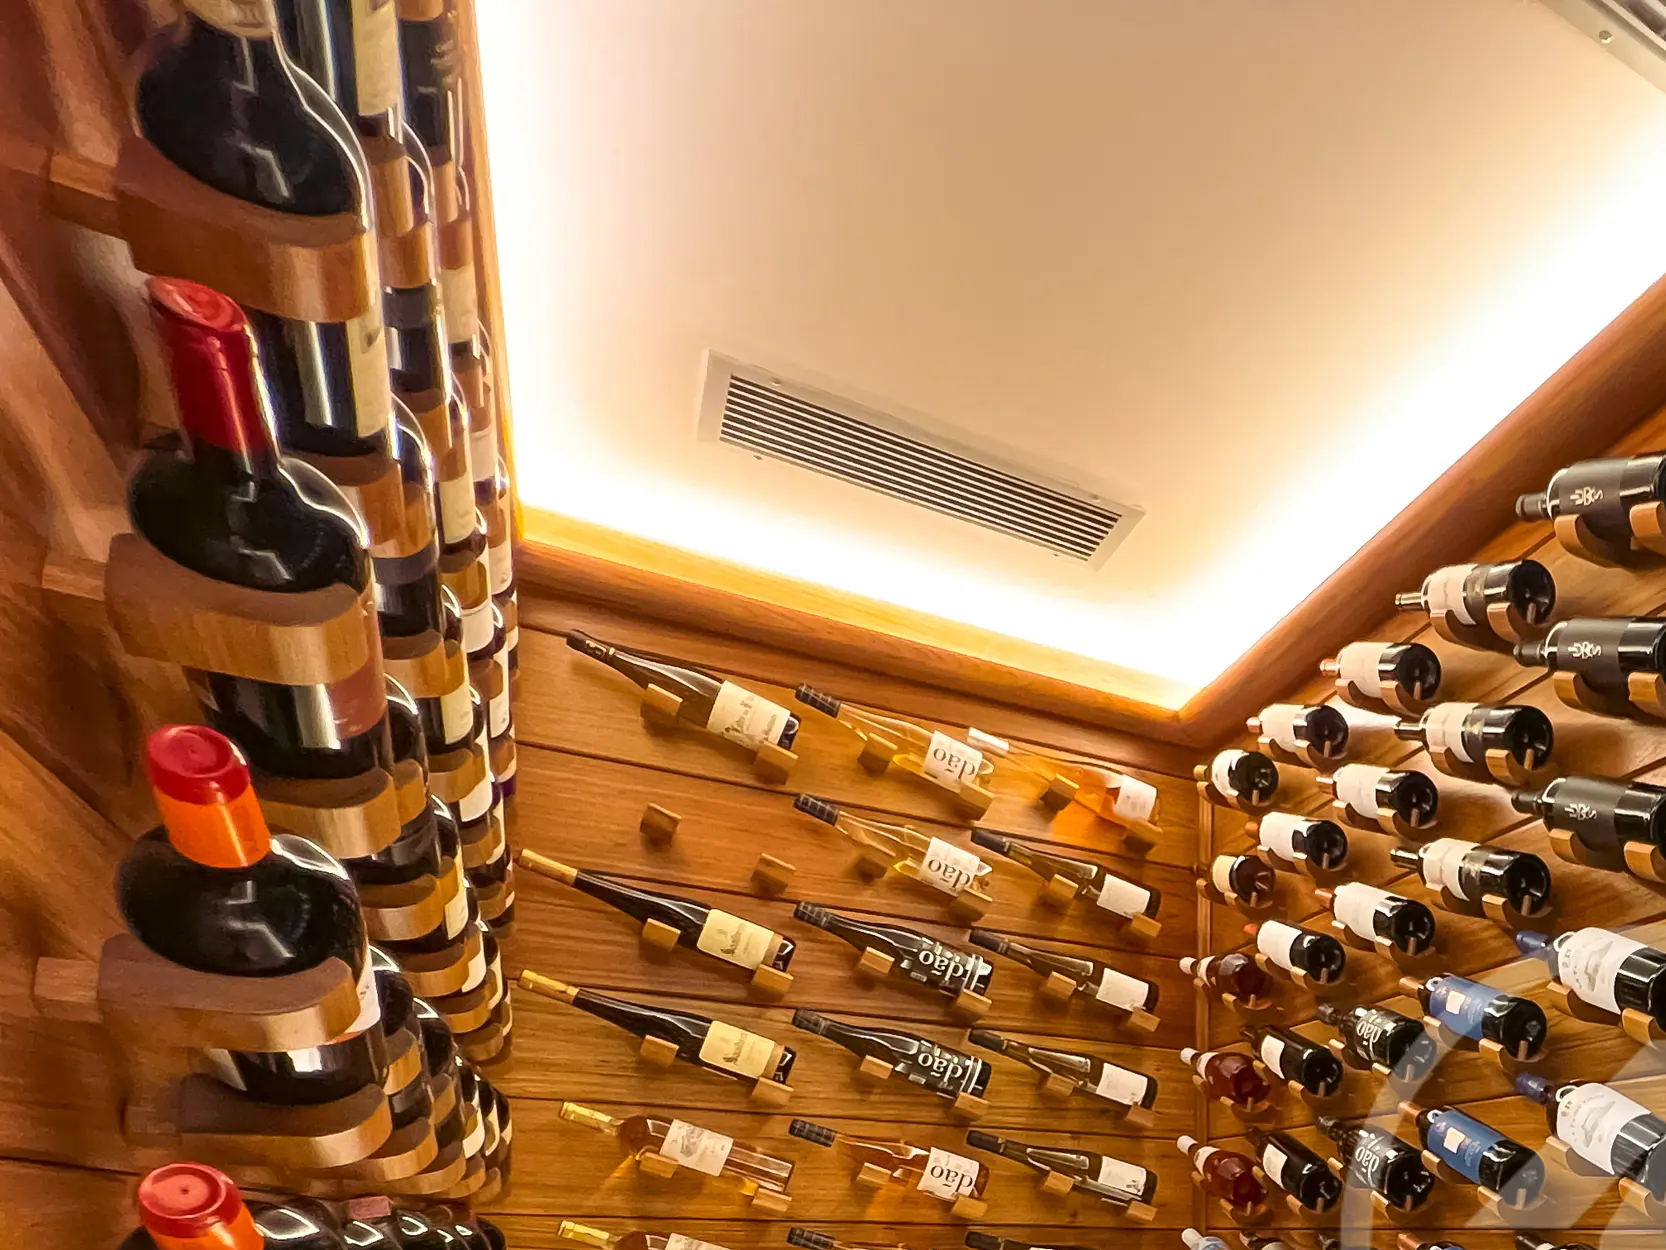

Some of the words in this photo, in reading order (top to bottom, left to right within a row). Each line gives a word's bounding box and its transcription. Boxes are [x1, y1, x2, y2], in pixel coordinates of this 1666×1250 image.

[933, 747, 976, 780] dão
[928, 858, 971, 891] dão
[919, 949, 965, 987] dão
[918, 1051, 963, 1086] dão
[930, 1164, 974, 1197] dão
